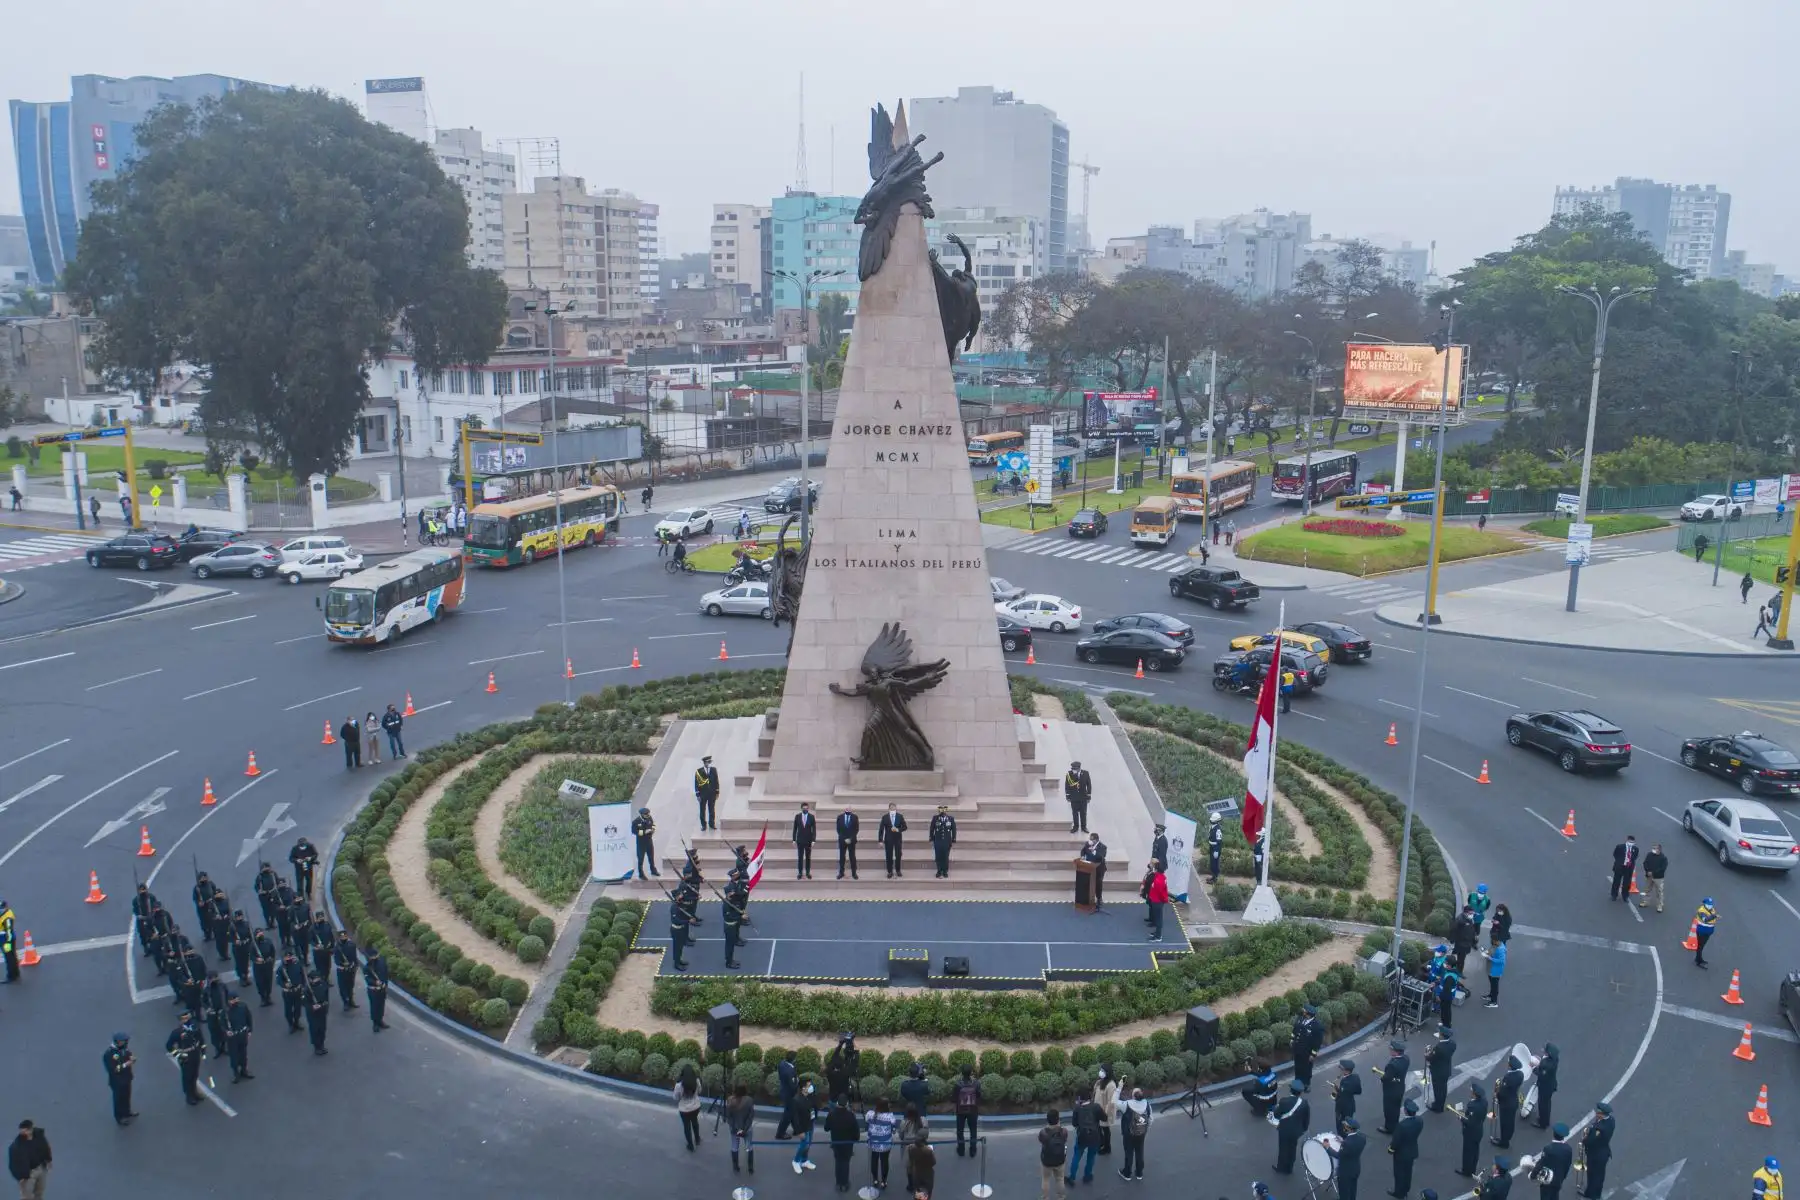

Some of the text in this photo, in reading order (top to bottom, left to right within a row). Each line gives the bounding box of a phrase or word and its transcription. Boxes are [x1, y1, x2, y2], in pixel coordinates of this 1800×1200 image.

[95, 127, 106, 166] UTP
[1350, 351, 1371, 360] PARA
[1368, 361, 1423, 372] REFRESCANTE
[894, 399, 903, 410] A
[844, 425, 953, 436] JORGE CHAVEZ
[875, 452, 920, 463] MCMX
[879, 529, 917, 538] LIMA
[894, 544, 902, 553] Y
[815, 557, 982, 569] LOS ITALIANOS DEL PERÚ
[596, 842, 628, 853] LIMA
